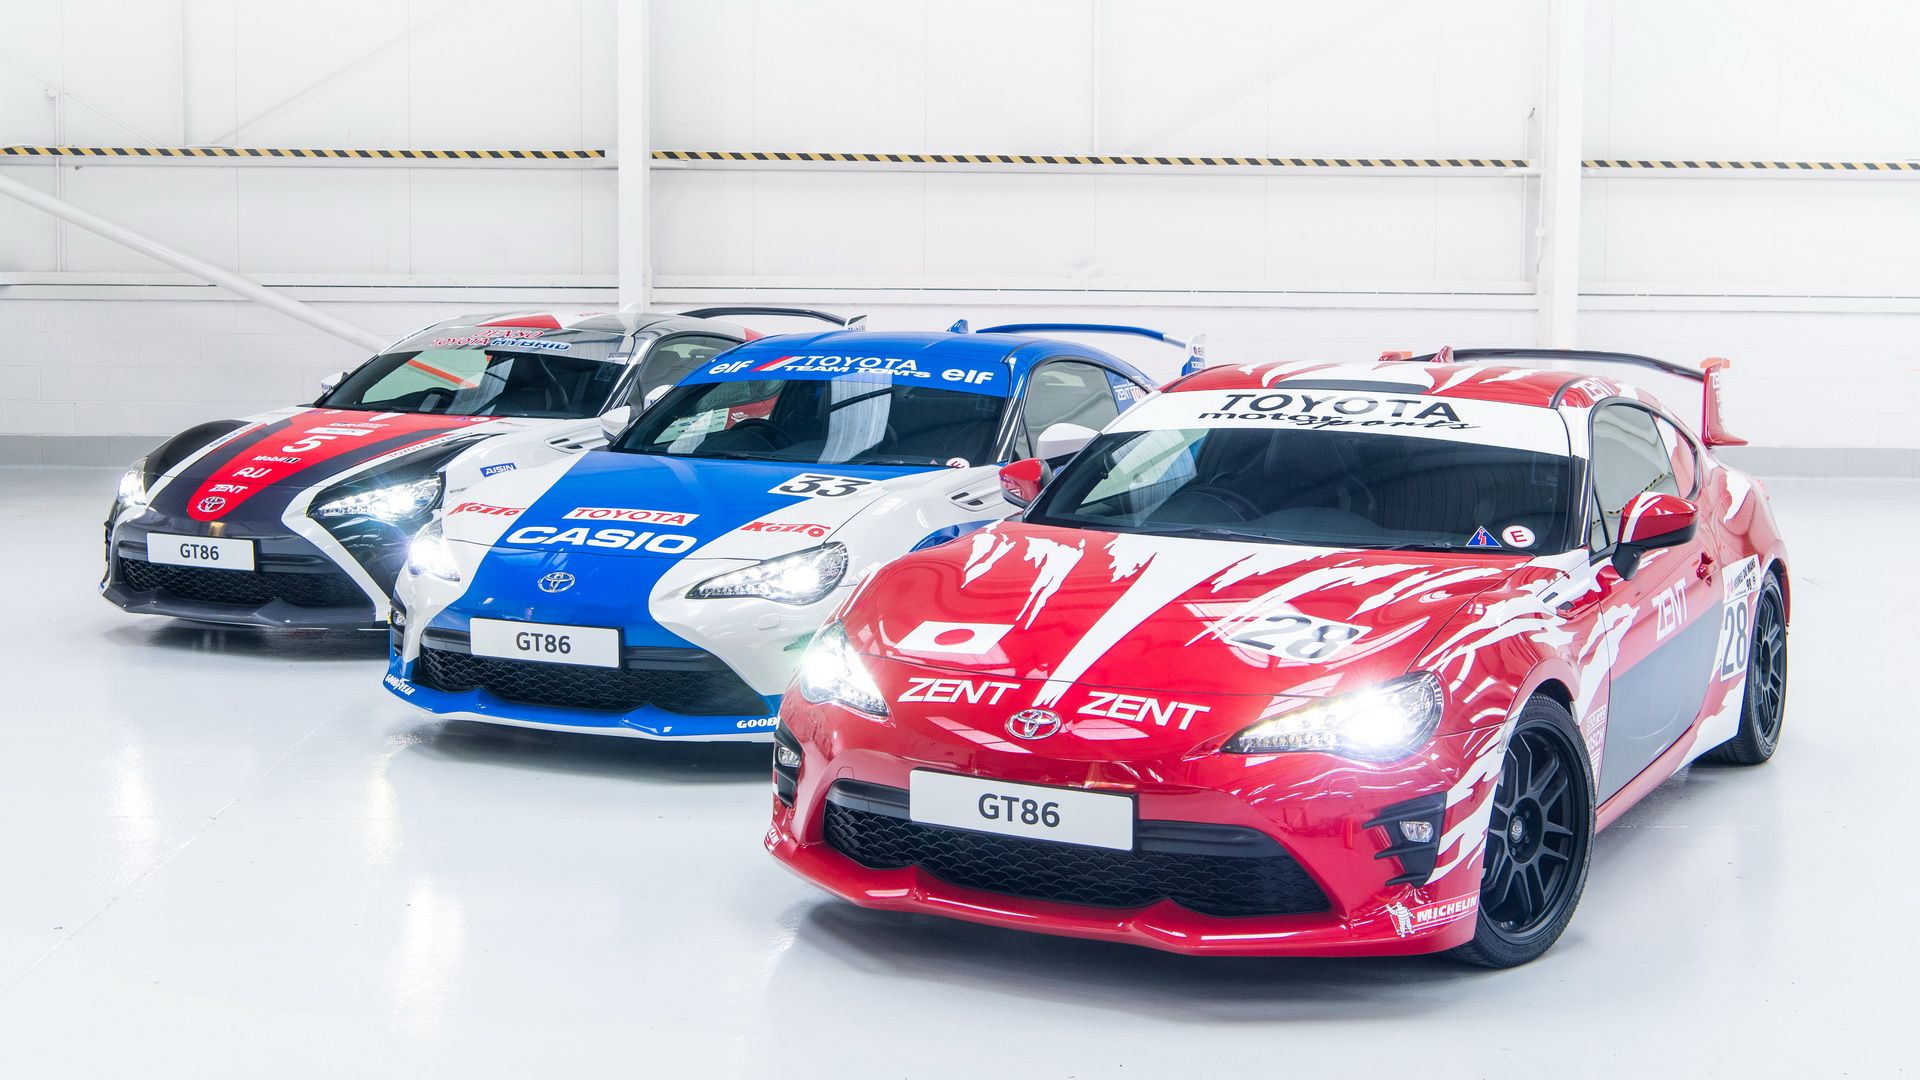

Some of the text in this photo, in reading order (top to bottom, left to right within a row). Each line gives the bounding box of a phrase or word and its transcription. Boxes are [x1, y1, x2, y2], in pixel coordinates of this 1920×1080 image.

[430, 337, 572, 351] TOYOTA HYBRID
[708, 359, 754, 375] elf
[783, 365, 931, 378] TEAM TOM'S
[805, 356, 917, 371] TOYOTA
[941, 368, 994, 385] elf
[1219, 393, 1463, 423] TOYOTA
[281, 435, 338, 453] 5
[485, 464, 514, 476] AISIN
[208, 484, 248, 494] ZENT
[779, 475, 872, 497] 33
[571, 508, 687, 525] TOYOTA
[505, 526, 698, 554] CASIO
[1509, 529, 1527, 544] E
[180, 543, 220, 561] GT86
[1651, 577, 1688, 642] ZENT
[515, 631, 572, 655] GT86
[1230, 614, 1360, 659] 28
[1721, 600, 1748, 678] 28
[896, 677, 1022, 706] ZENT
[1076, 691, 1212, 731] ZENT
[978, 792, 1061, 829] GT86
[1416, 894, 1478, 923] MICHELIN
